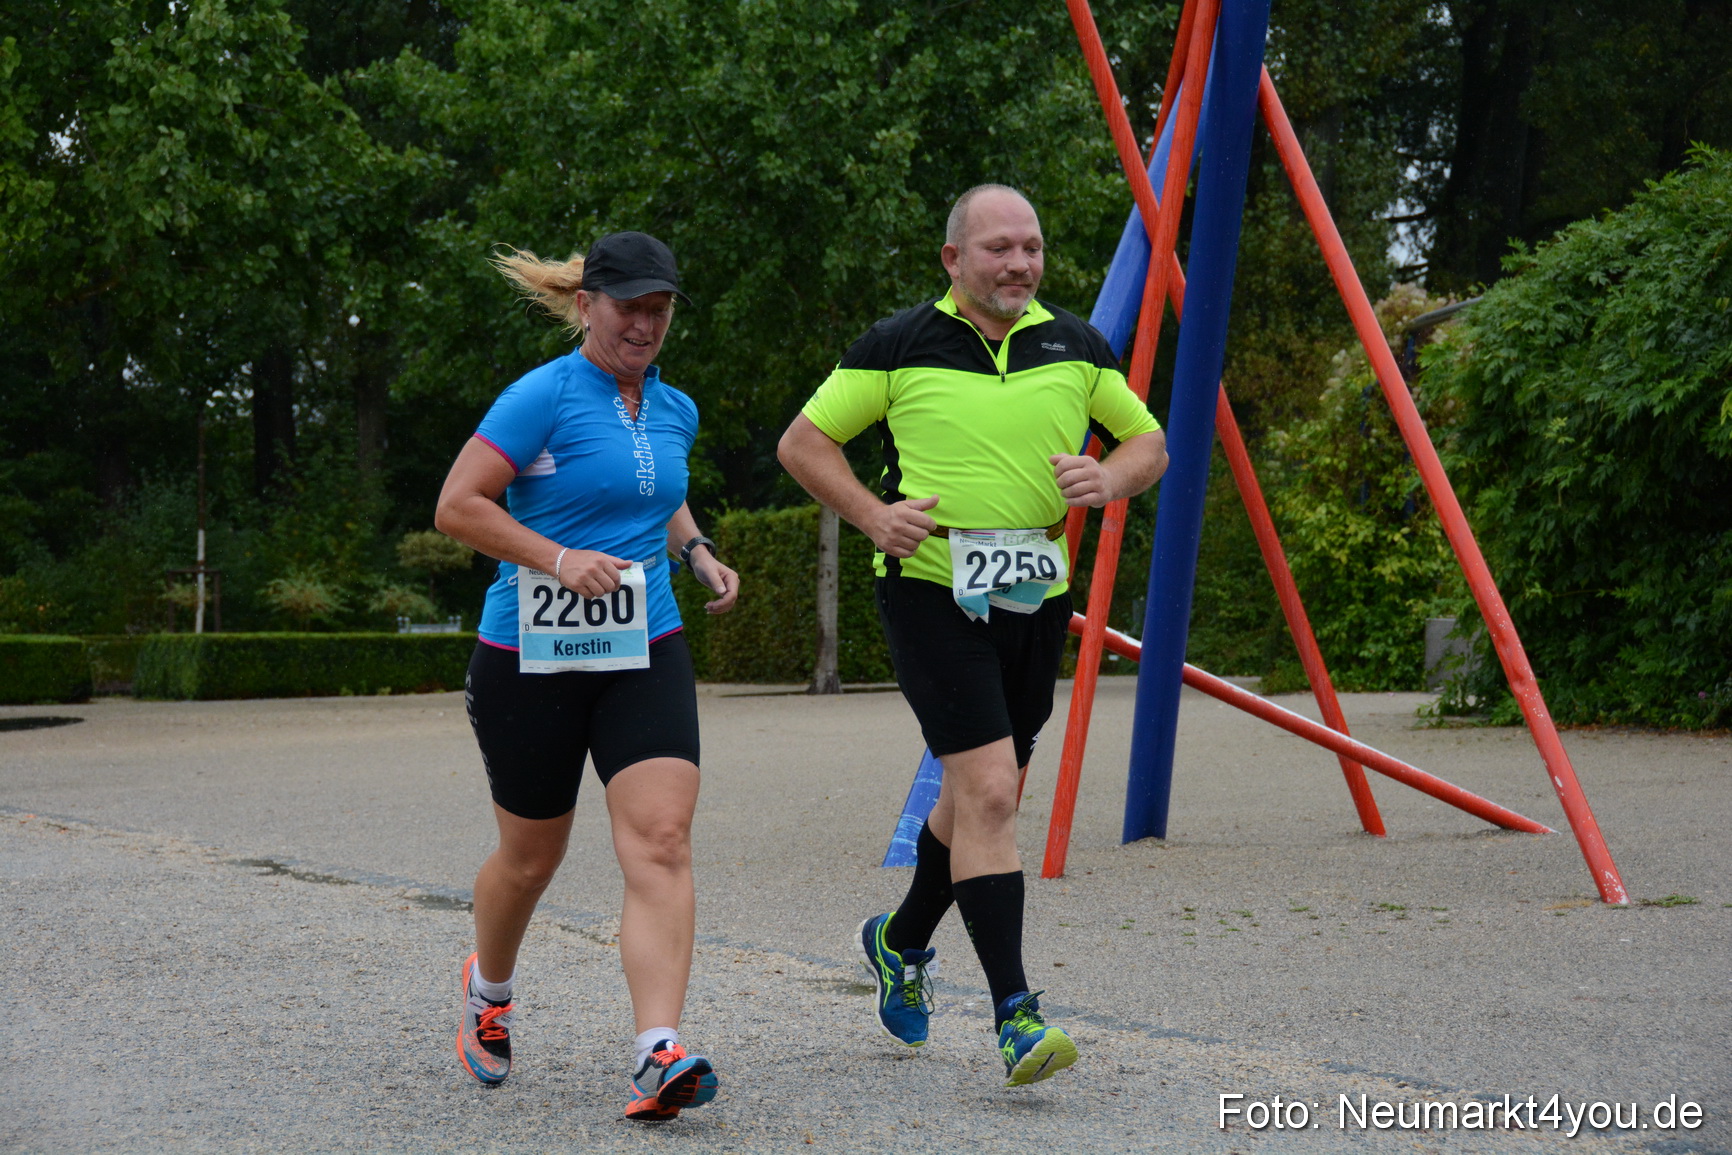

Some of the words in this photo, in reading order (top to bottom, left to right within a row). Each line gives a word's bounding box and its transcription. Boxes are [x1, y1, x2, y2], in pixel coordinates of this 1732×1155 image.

[966, 550, 1057, 590] 2259
[533, 584, 635, 627] 2260
[553, 638, 612, 656] Kerstin
